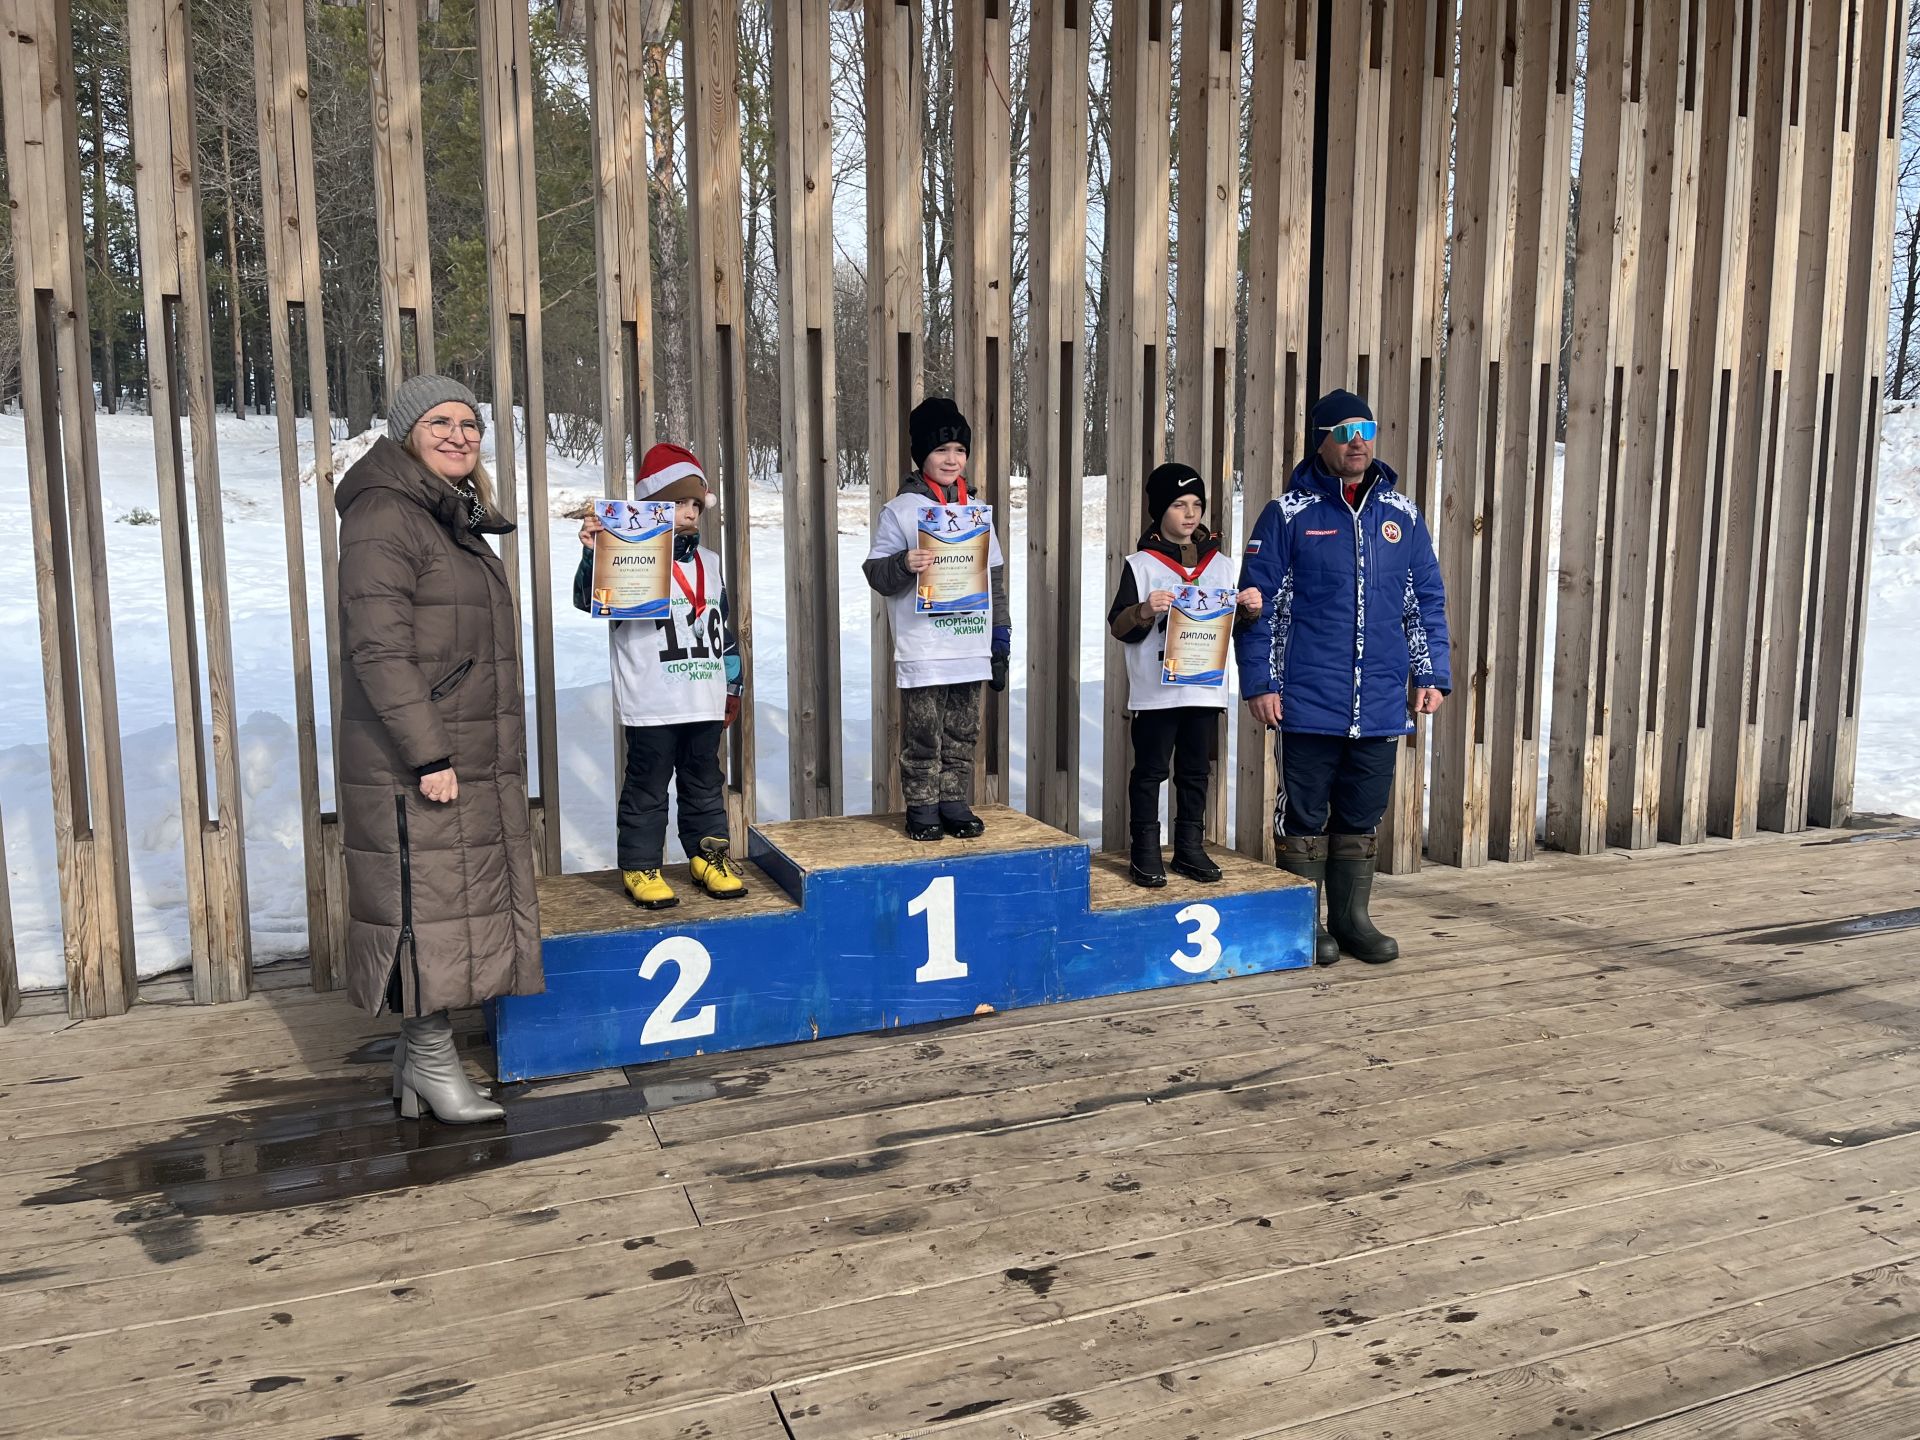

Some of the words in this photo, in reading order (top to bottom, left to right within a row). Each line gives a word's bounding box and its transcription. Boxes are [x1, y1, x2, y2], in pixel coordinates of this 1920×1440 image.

[612, 556, 656, 566] ДИПЛОМ
[933, 555, 974, 565] ДИПЛОМ
[655, 608, 722, 662] 116
[953, 625, 984, 635] ЖИЗНИ
[1180, 631, 1217, 641] ДИПЛОМ
[907, 875, 968, 983] 1
[1169, 903, 1222, 974] 3
[638, 935, 716, 1045] 2
